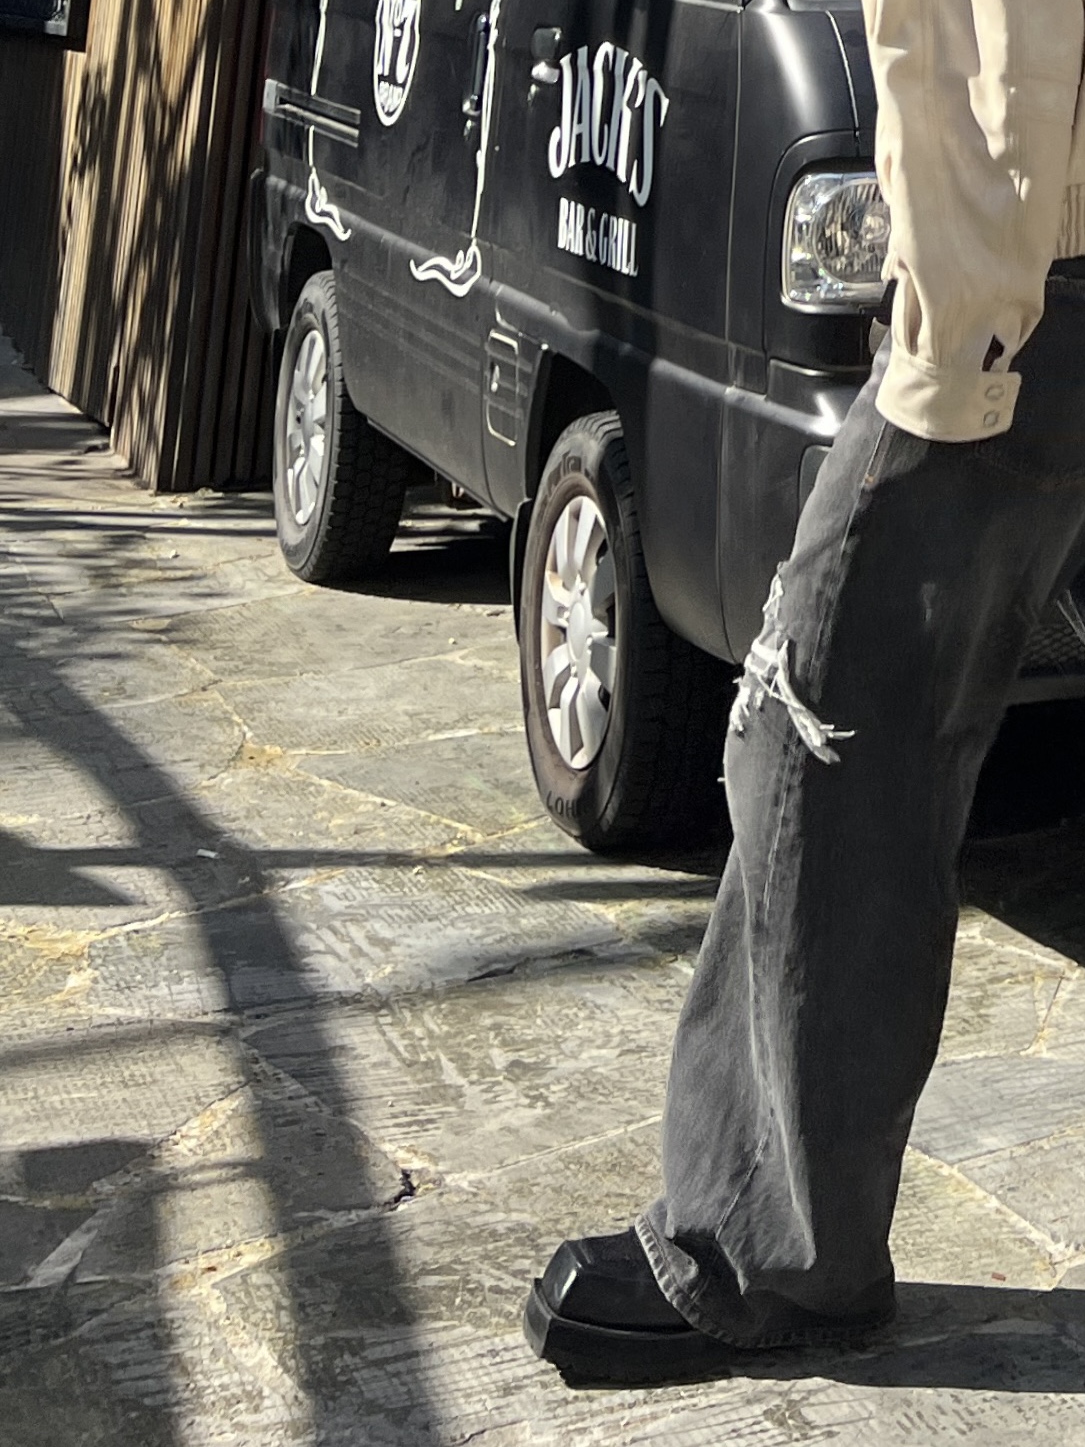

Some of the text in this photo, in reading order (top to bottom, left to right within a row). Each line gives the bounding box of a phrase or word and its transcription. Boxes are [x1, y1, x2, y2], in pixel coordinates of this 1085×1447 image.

[548, 41, 670, 208] JACK'S
[557, 197, 639, 278] BAR & GRILL
